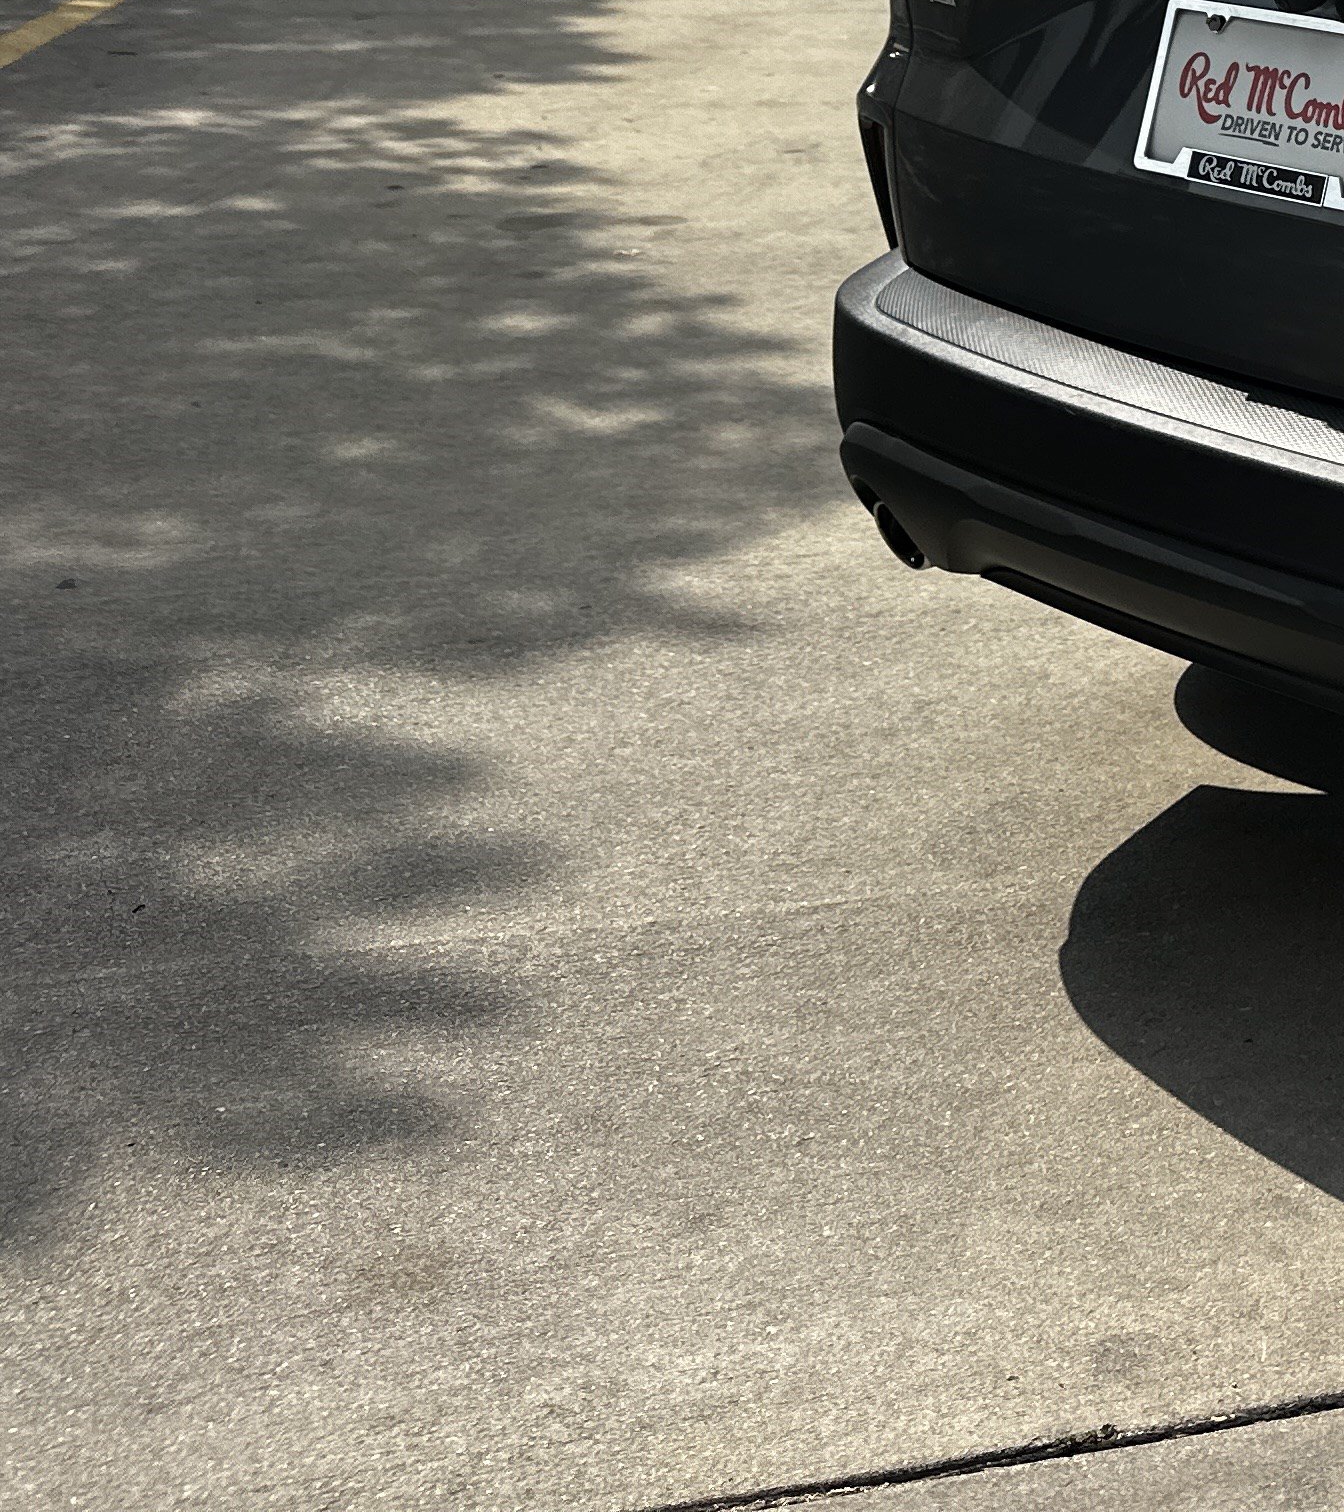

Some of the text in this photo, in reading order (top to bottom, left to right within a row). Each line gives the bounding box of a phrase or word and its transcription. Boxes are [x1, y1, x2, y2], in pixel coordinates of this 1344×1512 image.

[1179, 51, 1240, 125] Red
[1220, 113, 1284, 141] DRIVEN
[1286, 125, 1309, 146] TO
[1198, 155, 1313, 198] Red McCombs
